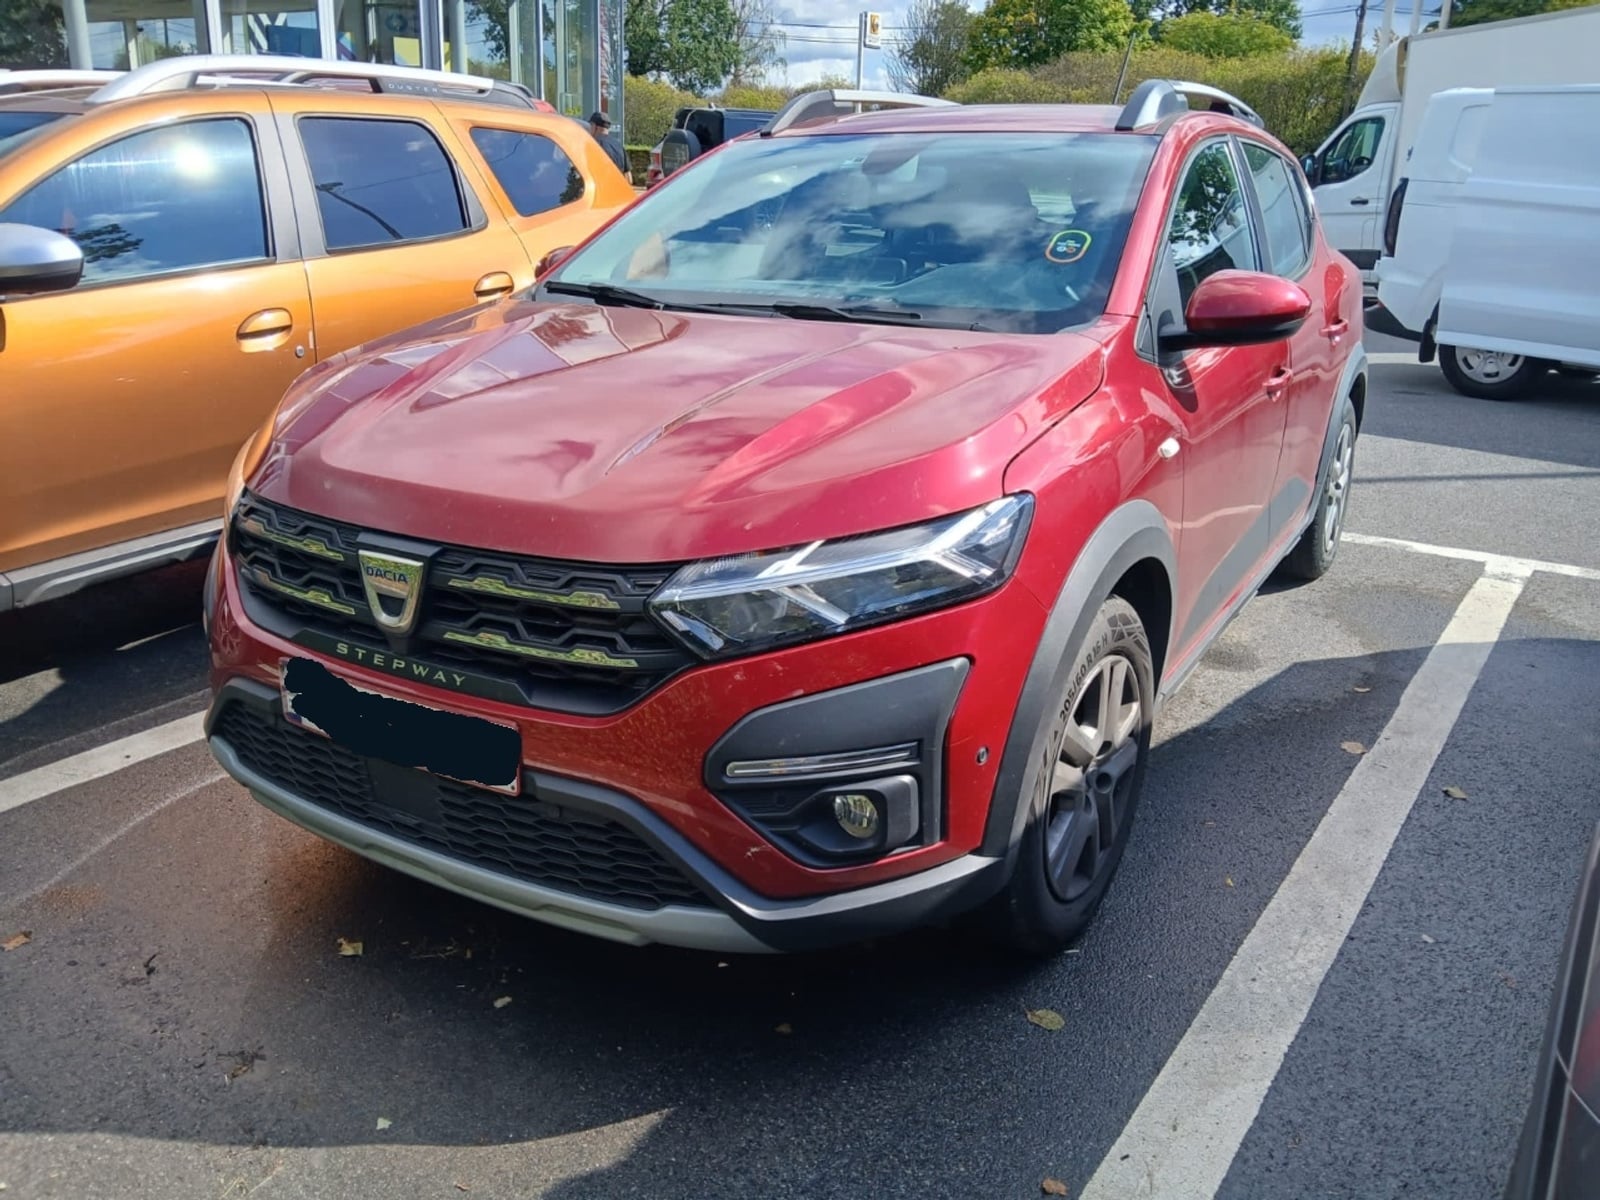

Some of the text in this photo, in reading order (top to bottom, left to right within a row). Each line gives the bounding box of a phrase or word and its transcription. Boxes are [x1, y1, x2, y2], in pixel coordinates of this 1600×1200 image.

[388, 83, 438, 93] DUSTER
[366, 566, 408, 584] DACIA
[336, 643, 466, 687] STEPWAY
